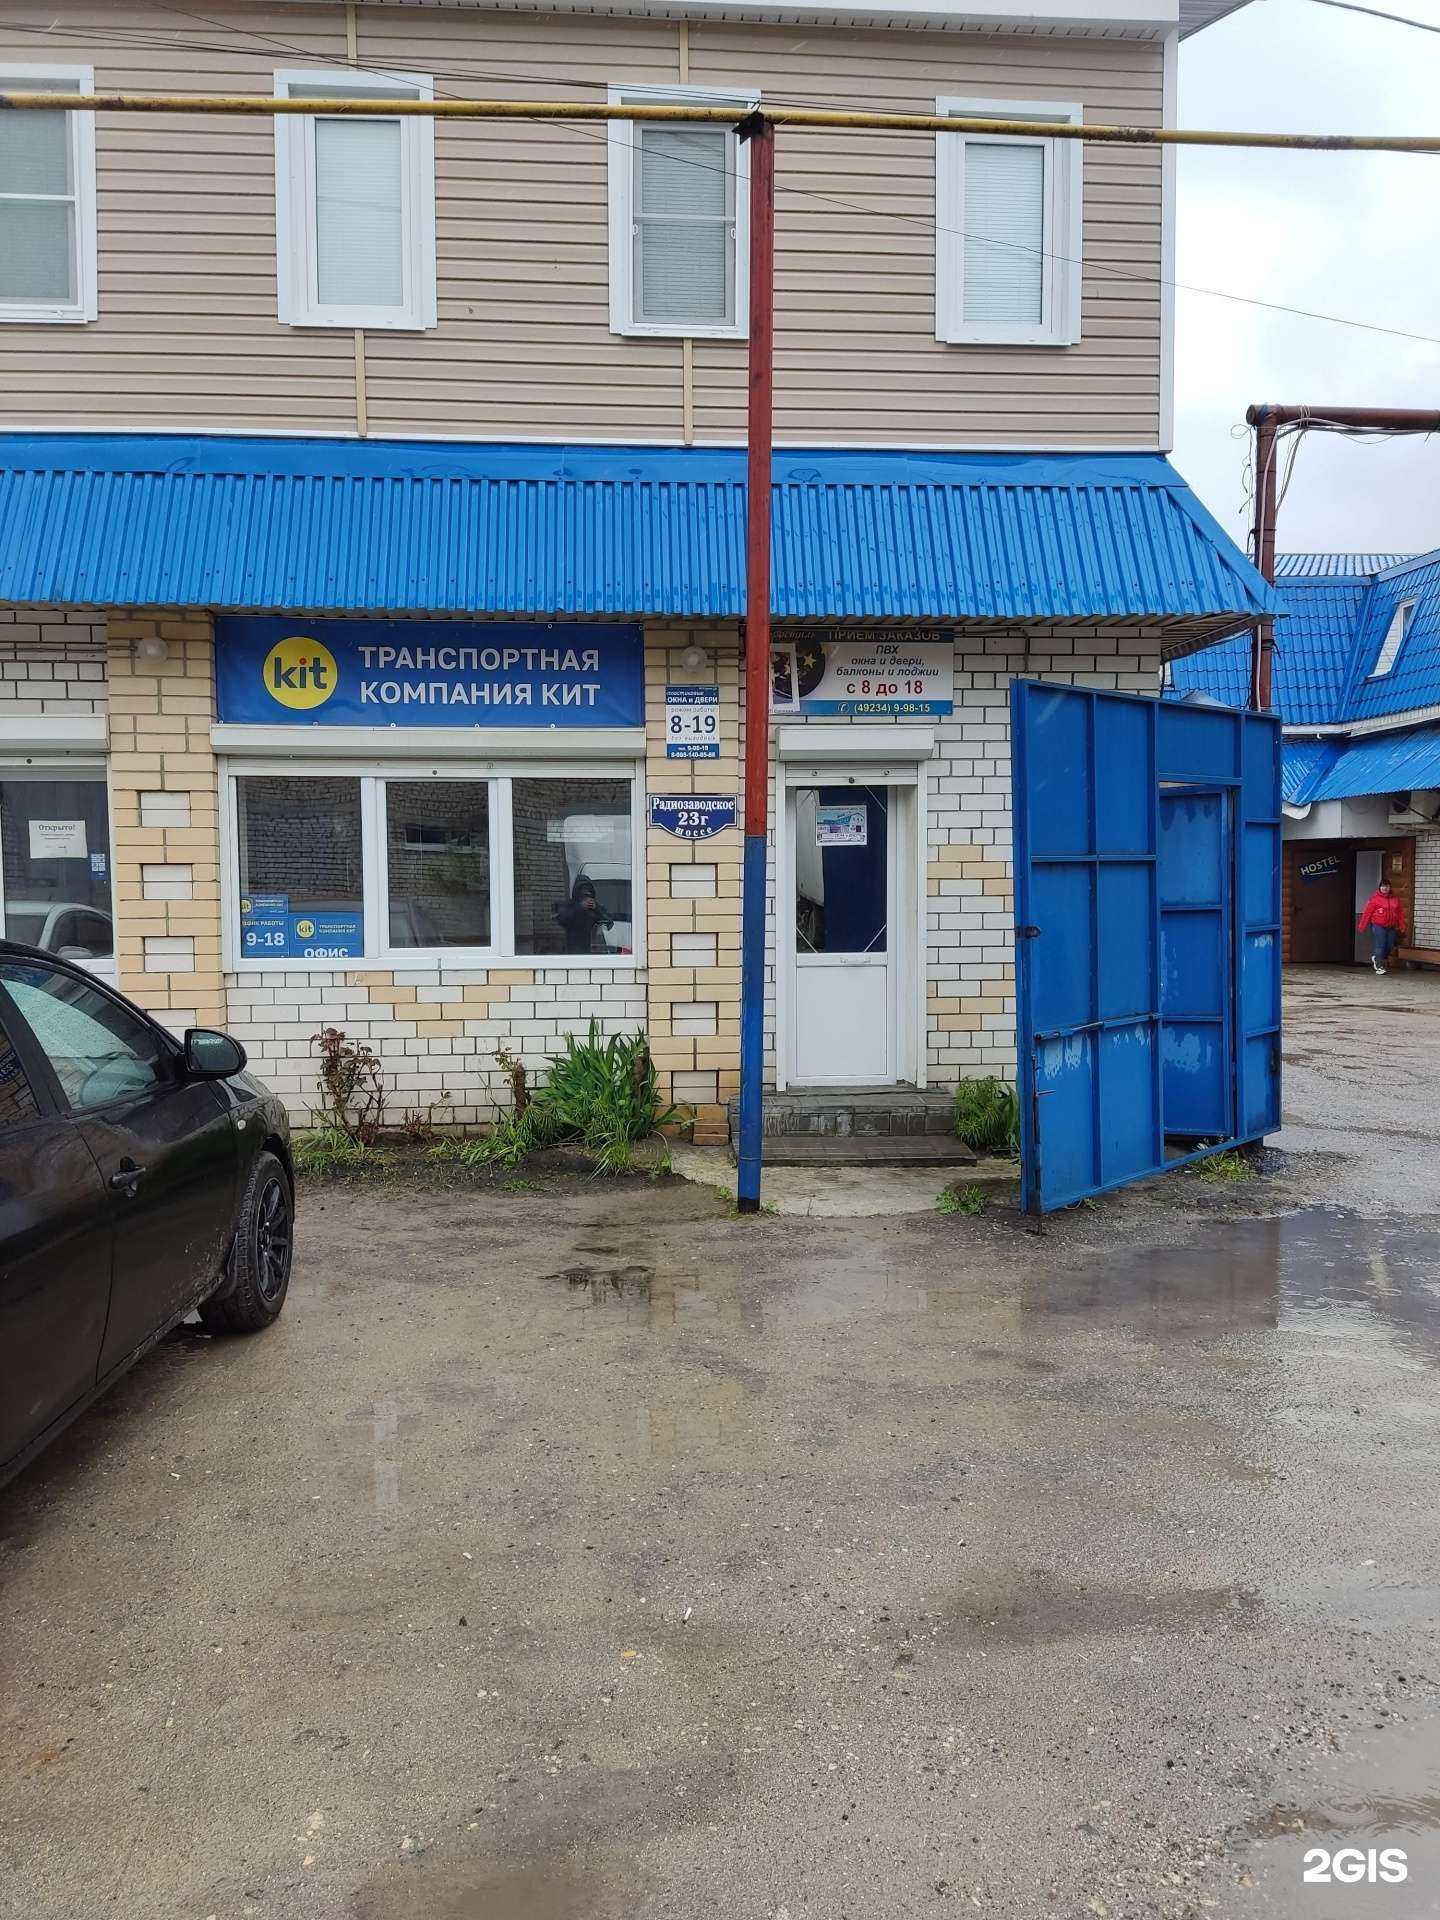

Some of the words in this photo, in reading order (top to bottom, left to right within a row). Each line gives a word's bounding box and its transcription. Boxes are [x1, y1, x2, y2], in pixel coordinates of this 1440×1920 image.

[875, 645, 900, 655] ПВХ
[357, 646, 600, 671] ТРАНСПОРТНАЯ
[850, 656, 876, 665] окна
[879, 657, 887, 665] и
[889, 655, 925, 666] двери,
[273, 656, 328, 689] kit
[836, 667, 884, 676] балконы
[888, 668, 895, 676] и
[897, 667, 939, 677] лоджии
[359, 681, 532, 705] КОМПАНИЯ
[541, 682, 601, 706] КИТ
[846, 683, 856, 694] с
[861, 680, 871, 694] 8
[876, 683, 898, 697] до
[904, 680, 924, 694] 18
[694, 697, 718, 705] ДВЕРИ
[854, 703, 891, 713] (49234)
[894, 703, 931, 712] 9-98-15
[670, 715, 716, 733] 8-19
[652, 797, 734, 811] Радиозаводское
[677, 811, 709, 826] 23г
[674, 826, 713, 837] шоссе
[1300, 855, 1341, 875] HOSTEL
[299, 924, 313, 933] kit
[246, 932, 285, 946] 9-18
[303, 948, 349, 957] ОФИС
